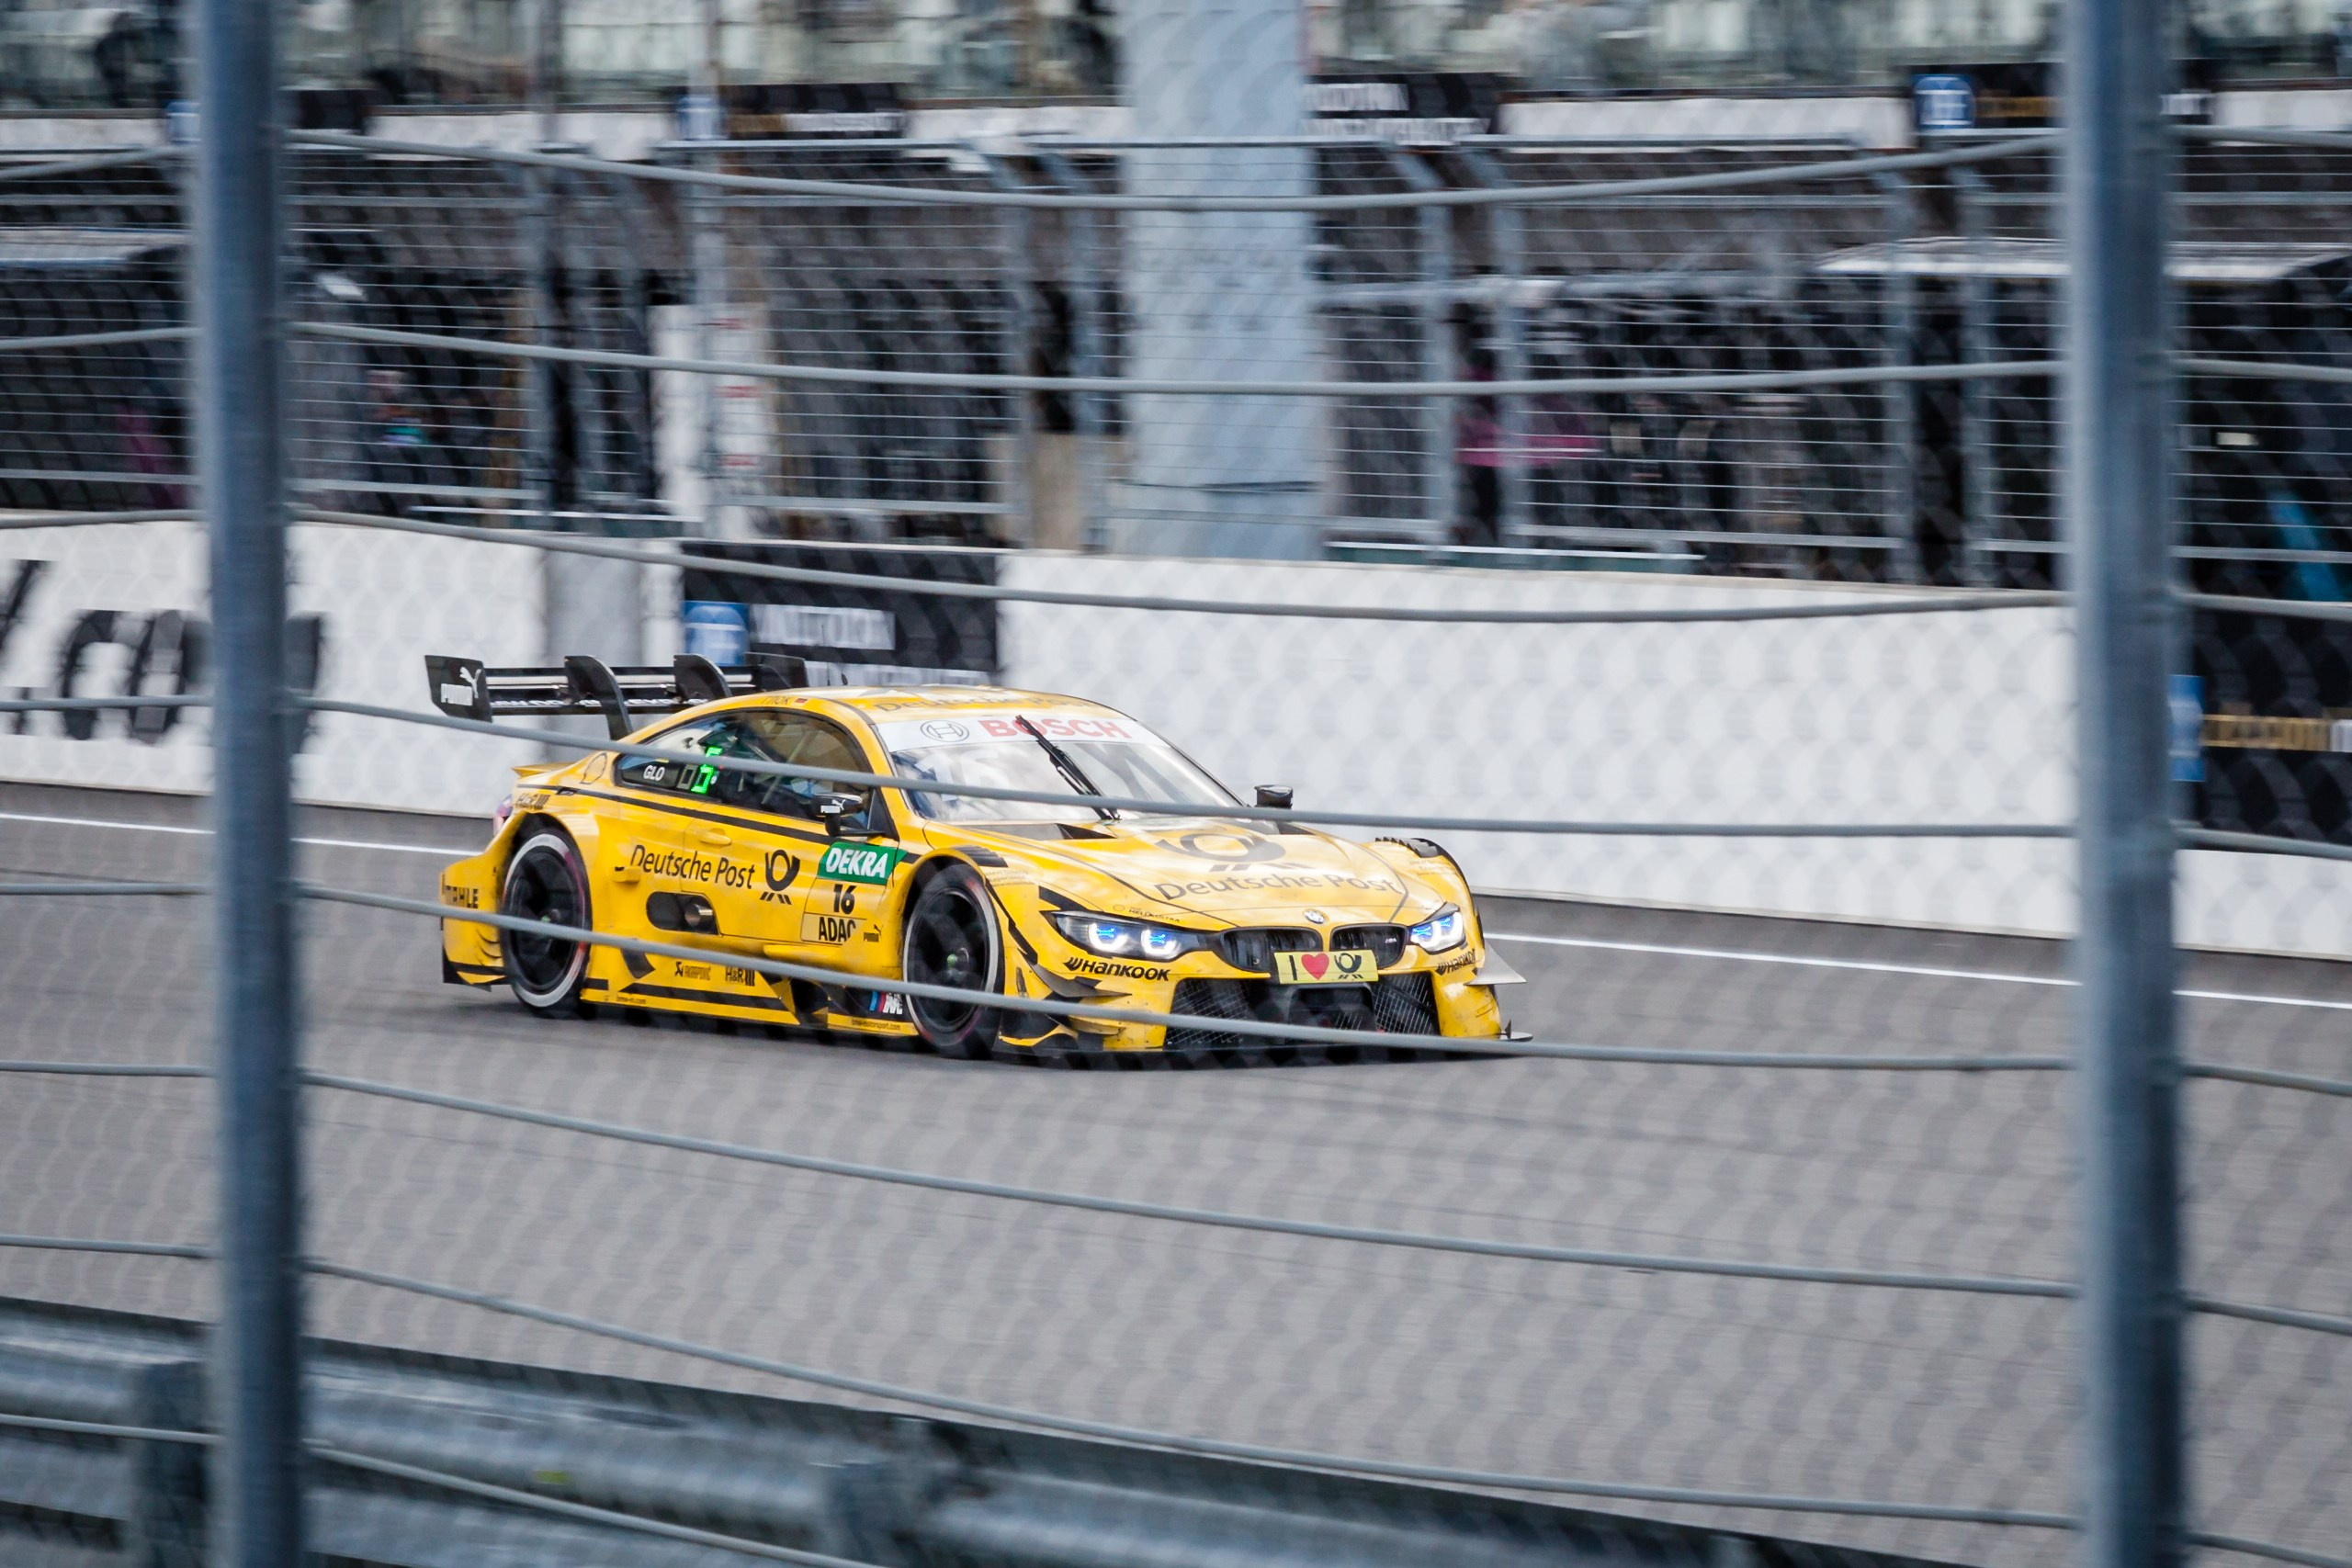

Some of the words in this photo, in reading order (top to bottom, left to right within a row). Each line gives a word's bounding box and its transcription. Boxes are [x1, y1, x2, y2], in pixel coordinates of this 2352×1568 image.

[978, 719, 1133, 740] BOSCH
[643, 764, 665, 782] GLO
[629, 844, 712, 882] Deutsche
[715, 857, 755, 889] Post
[825, 847, 888, 878] DEKRA
[833, 884, 856, 915] 16
[1154, 872, 1319, 900] Deutsche
[1321, 872, 1403, 896] Post
